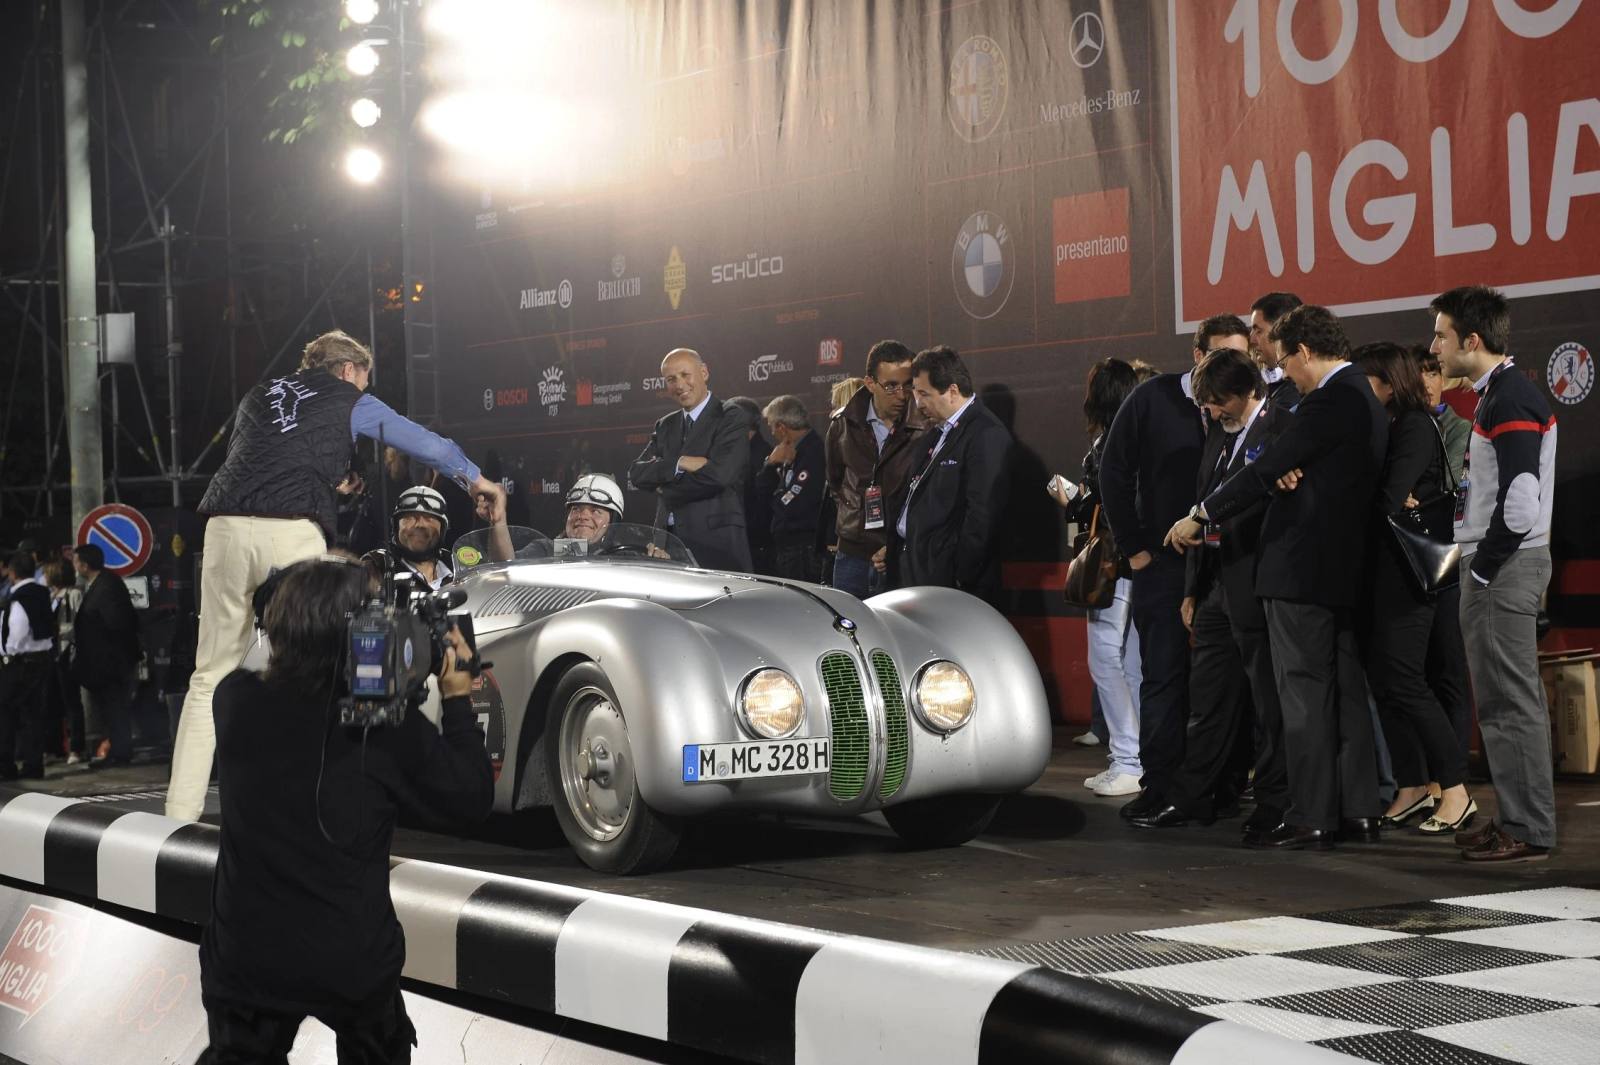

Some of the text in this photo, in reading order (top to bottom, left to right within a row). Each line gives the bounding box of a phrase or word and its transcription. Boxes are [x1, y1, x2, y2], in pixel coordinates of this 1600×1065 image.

[1040, 88, 1141, 124] Mercedes-Benz
[959, 214, 1008, 251] BMW
[1056, 233, 1128, 266] presentano
[711, 253, 783, 284] SCHÜCO
[520, 289, 557, 309] Allianz
[820, 340, 838, 361] RDS
[748, 362, 769, 382] RCS
[496, 388, 528, 406] BOSCH
[700, 748, 716, 776] M
[731, 746, 762, 774] MC
